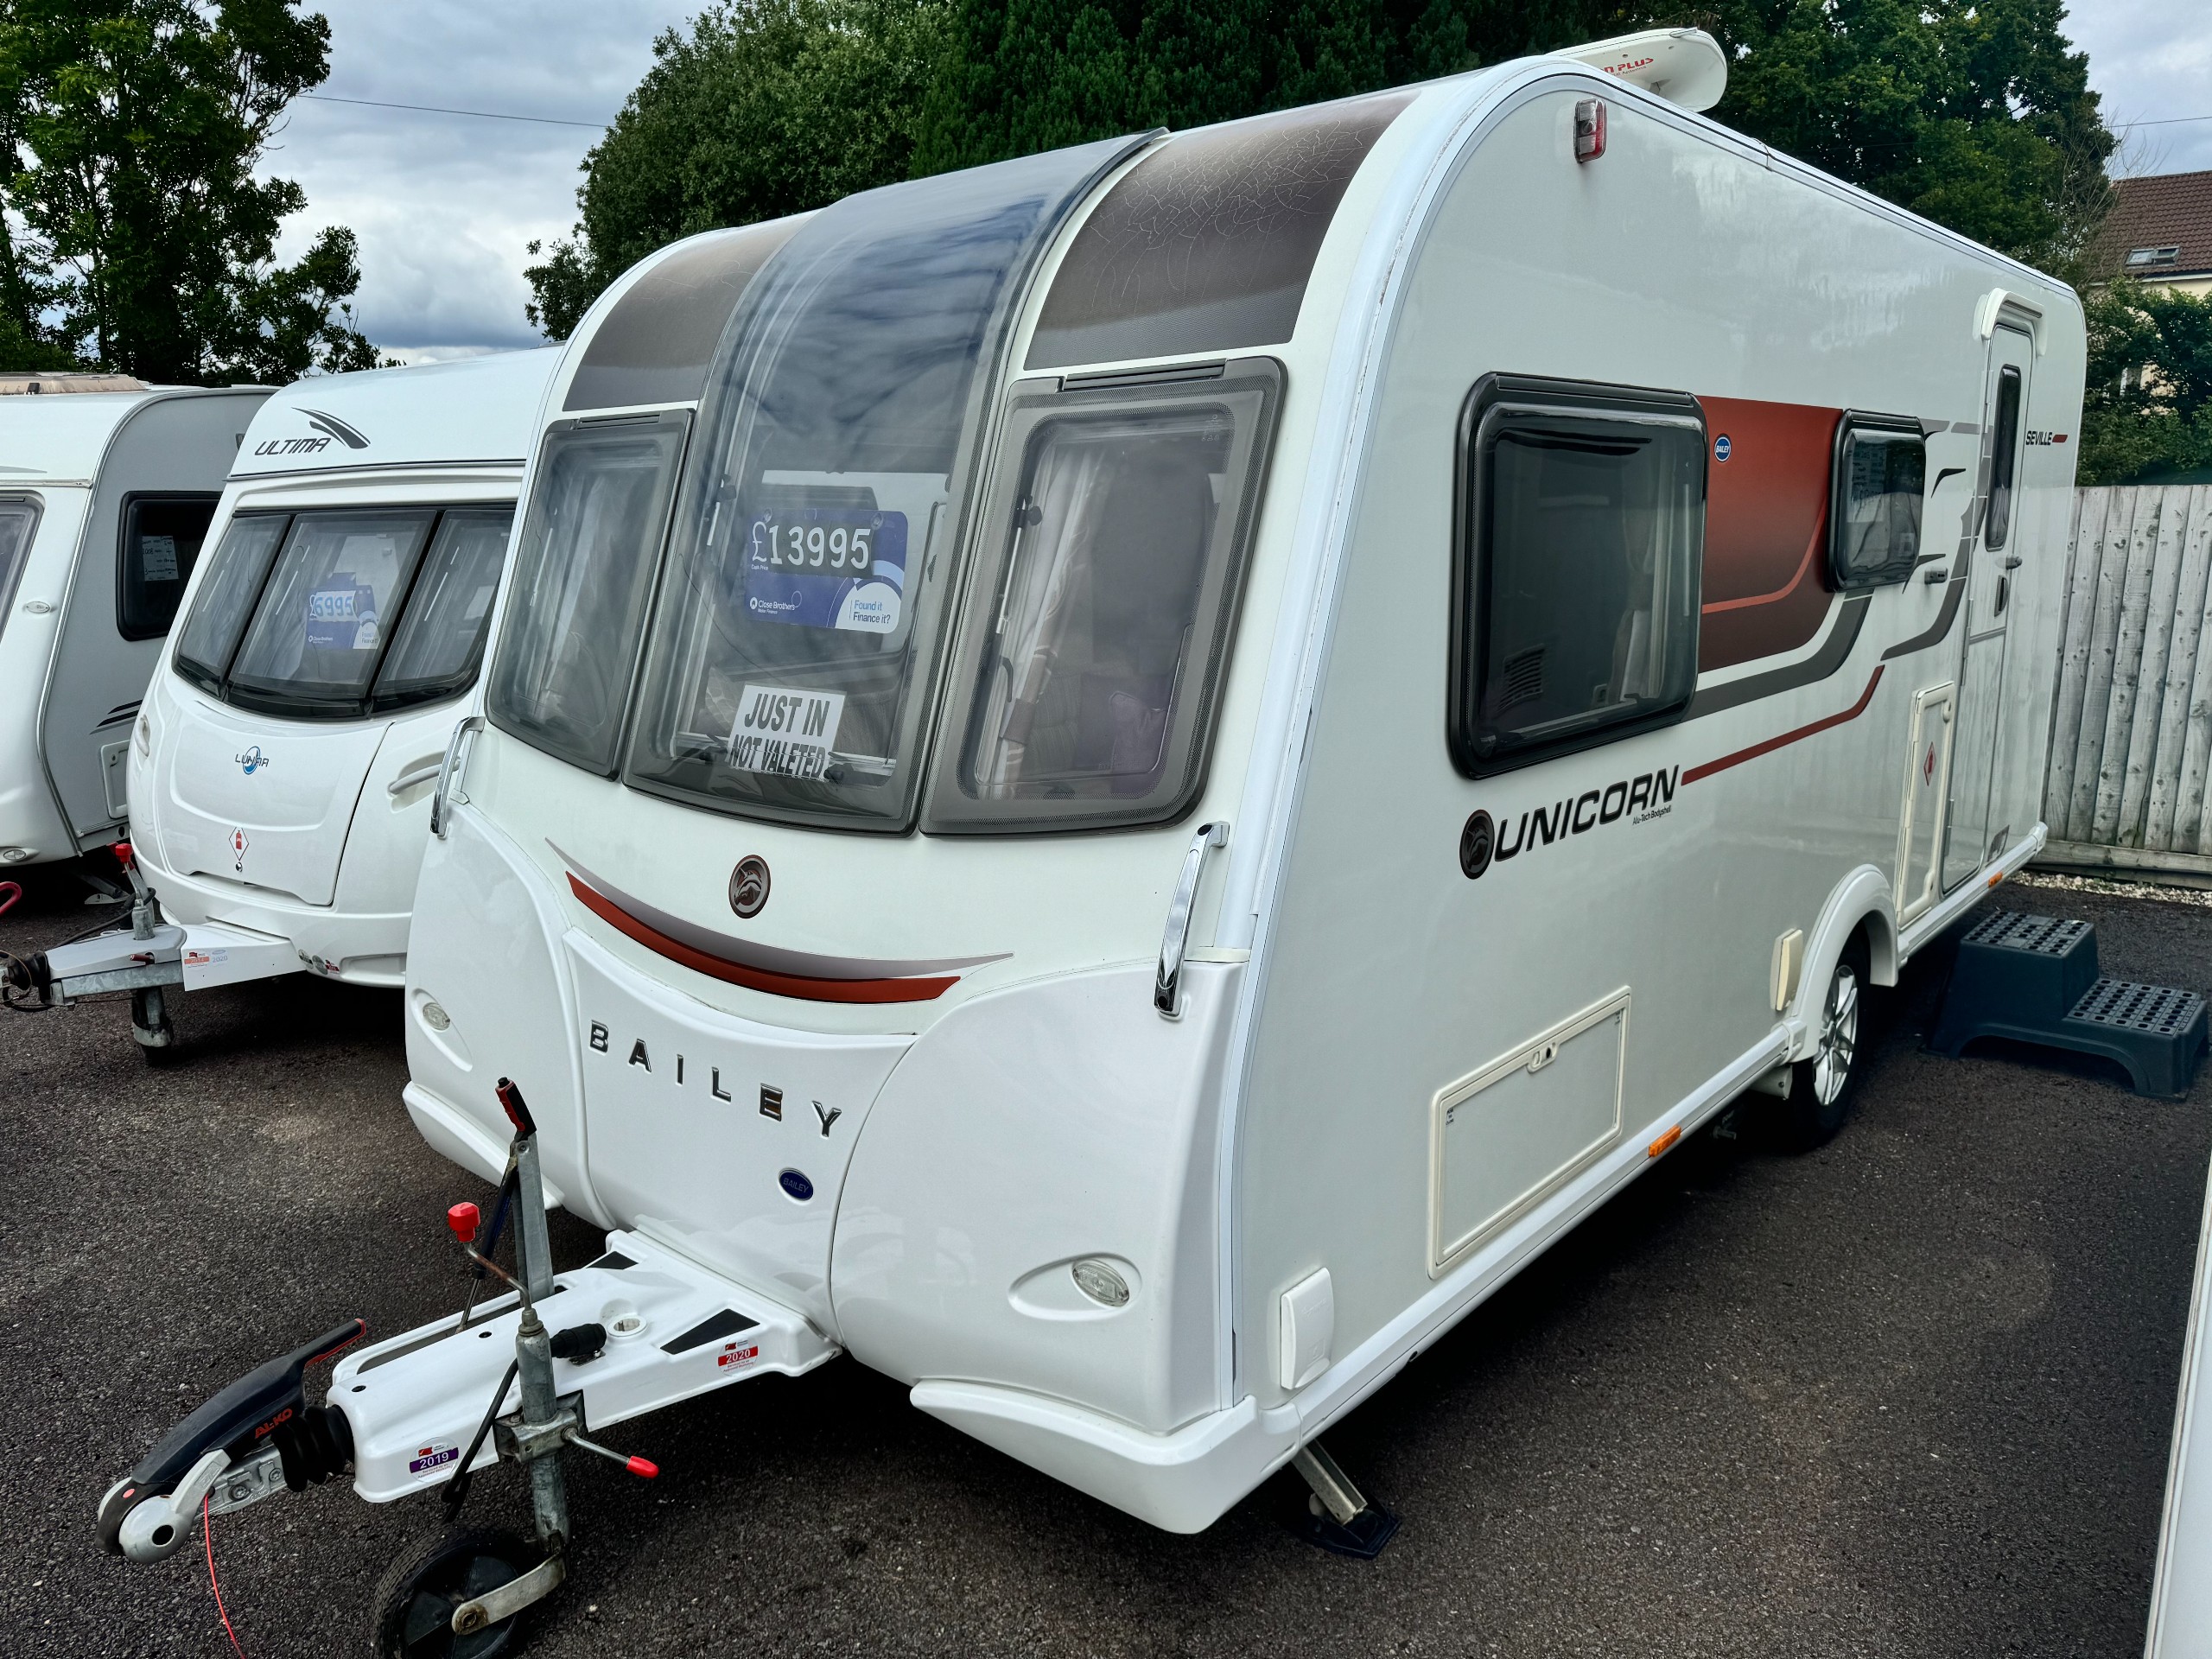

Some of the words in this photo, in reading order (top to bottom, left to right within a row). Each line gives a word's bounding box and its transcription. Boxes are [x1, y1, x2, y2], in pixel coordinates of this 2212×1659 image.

[1618, 57, 1655, 71] PLUS
[2025, 430, 2053, 446] SEVILLE
[254, 437, 332, 456] ULTIMA
[758, 600, 773, 608] Close
[772, 601, 796, 611] Brothers
[854, 599, 877, 611] Found
[877, 601, 883, 611] it
[853, 611, 880, 623] Finance
[880, 613, 891, 624] it?
[744, 693, 803, 733] JUST
[802, 699, 830, 737] IN
[234, 753, 270, 767] LUNAR
[731, 734, 763, 769] NOT
[760, 738, 827, 779] VALETED
[1494, 764, 1680, 862] UNICORN
[1650, 804, 1672, 818] Bodyshell
[589, 1020, 842, 1138] BAILEY
[783, 1177, 810, 1193] BAILEY
[726, 1349, 751, 1363] 2020
[254, 1408, 293, 1440] AL-KO
[419, 1452, 448, 1470] 2019
